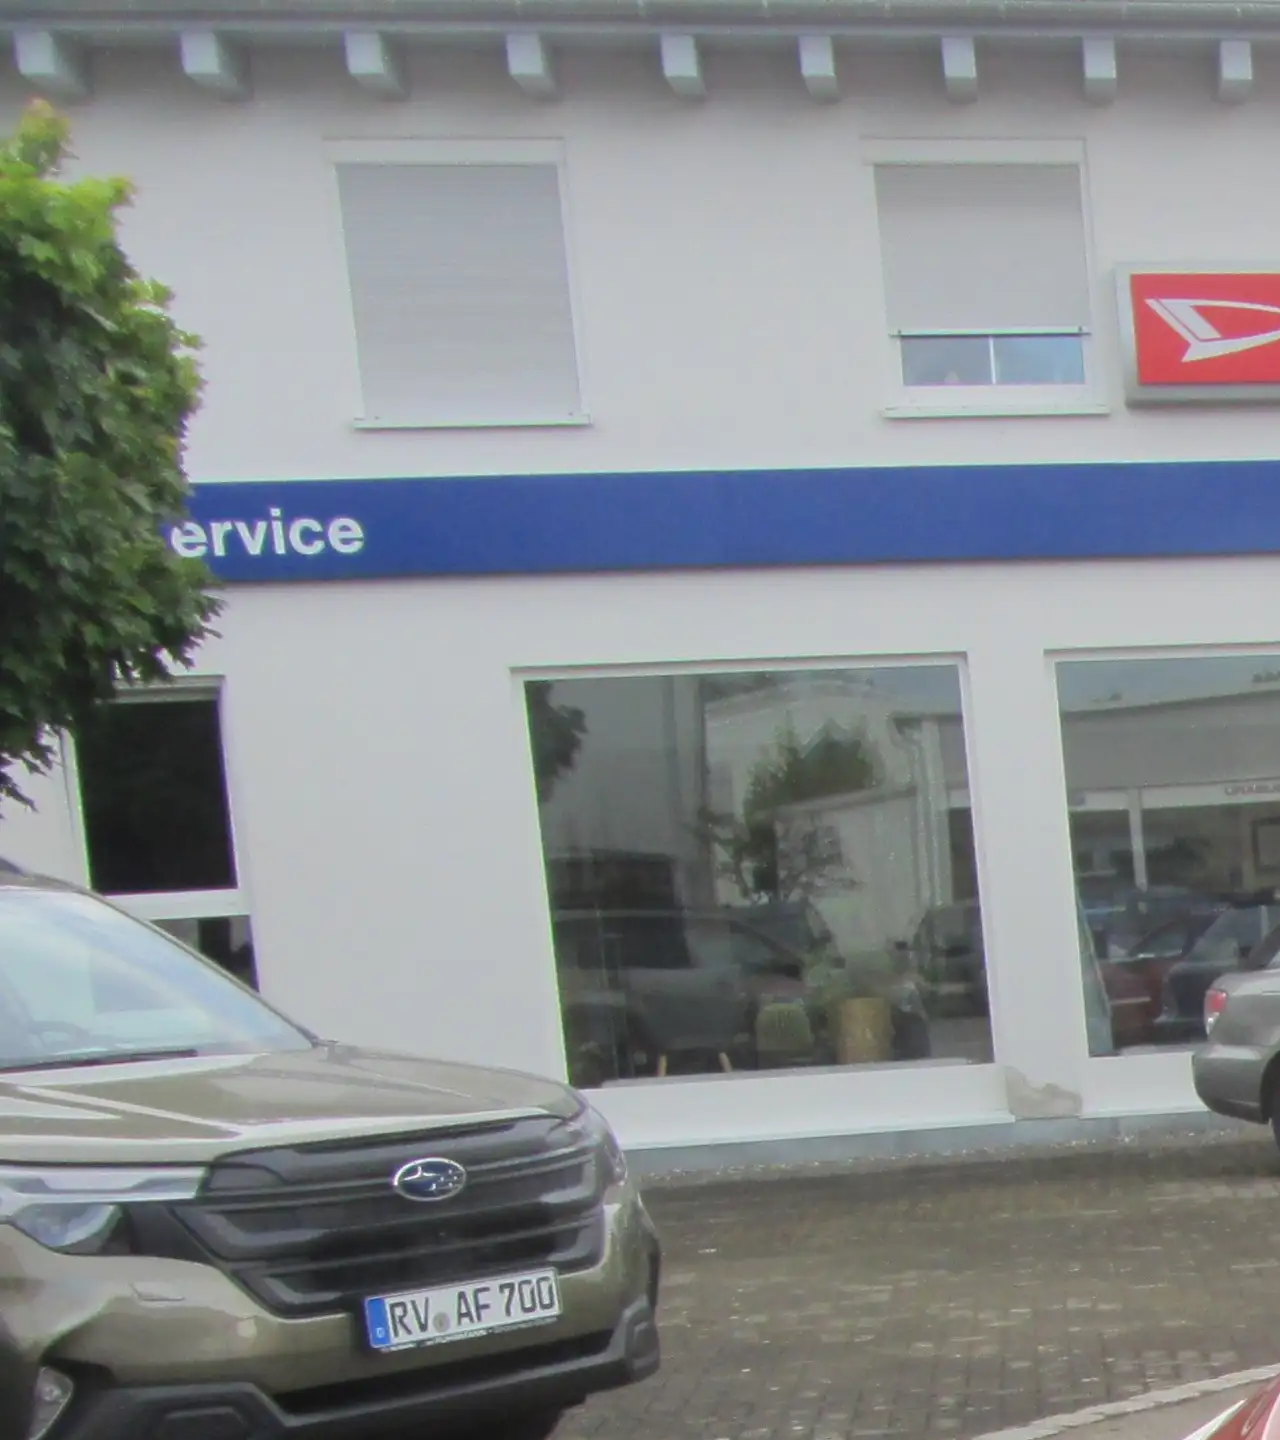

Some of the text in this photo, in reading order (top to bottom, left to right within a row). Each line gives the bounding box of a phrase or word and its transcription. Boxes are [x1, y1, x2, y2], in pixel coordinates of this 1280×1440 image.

[169, 507, 365, 558] ervice
[389, 1297, 430, 1338] RV
[456, 1287, 491, 1326] AF
[498, 1276, 555, 1318] 700
